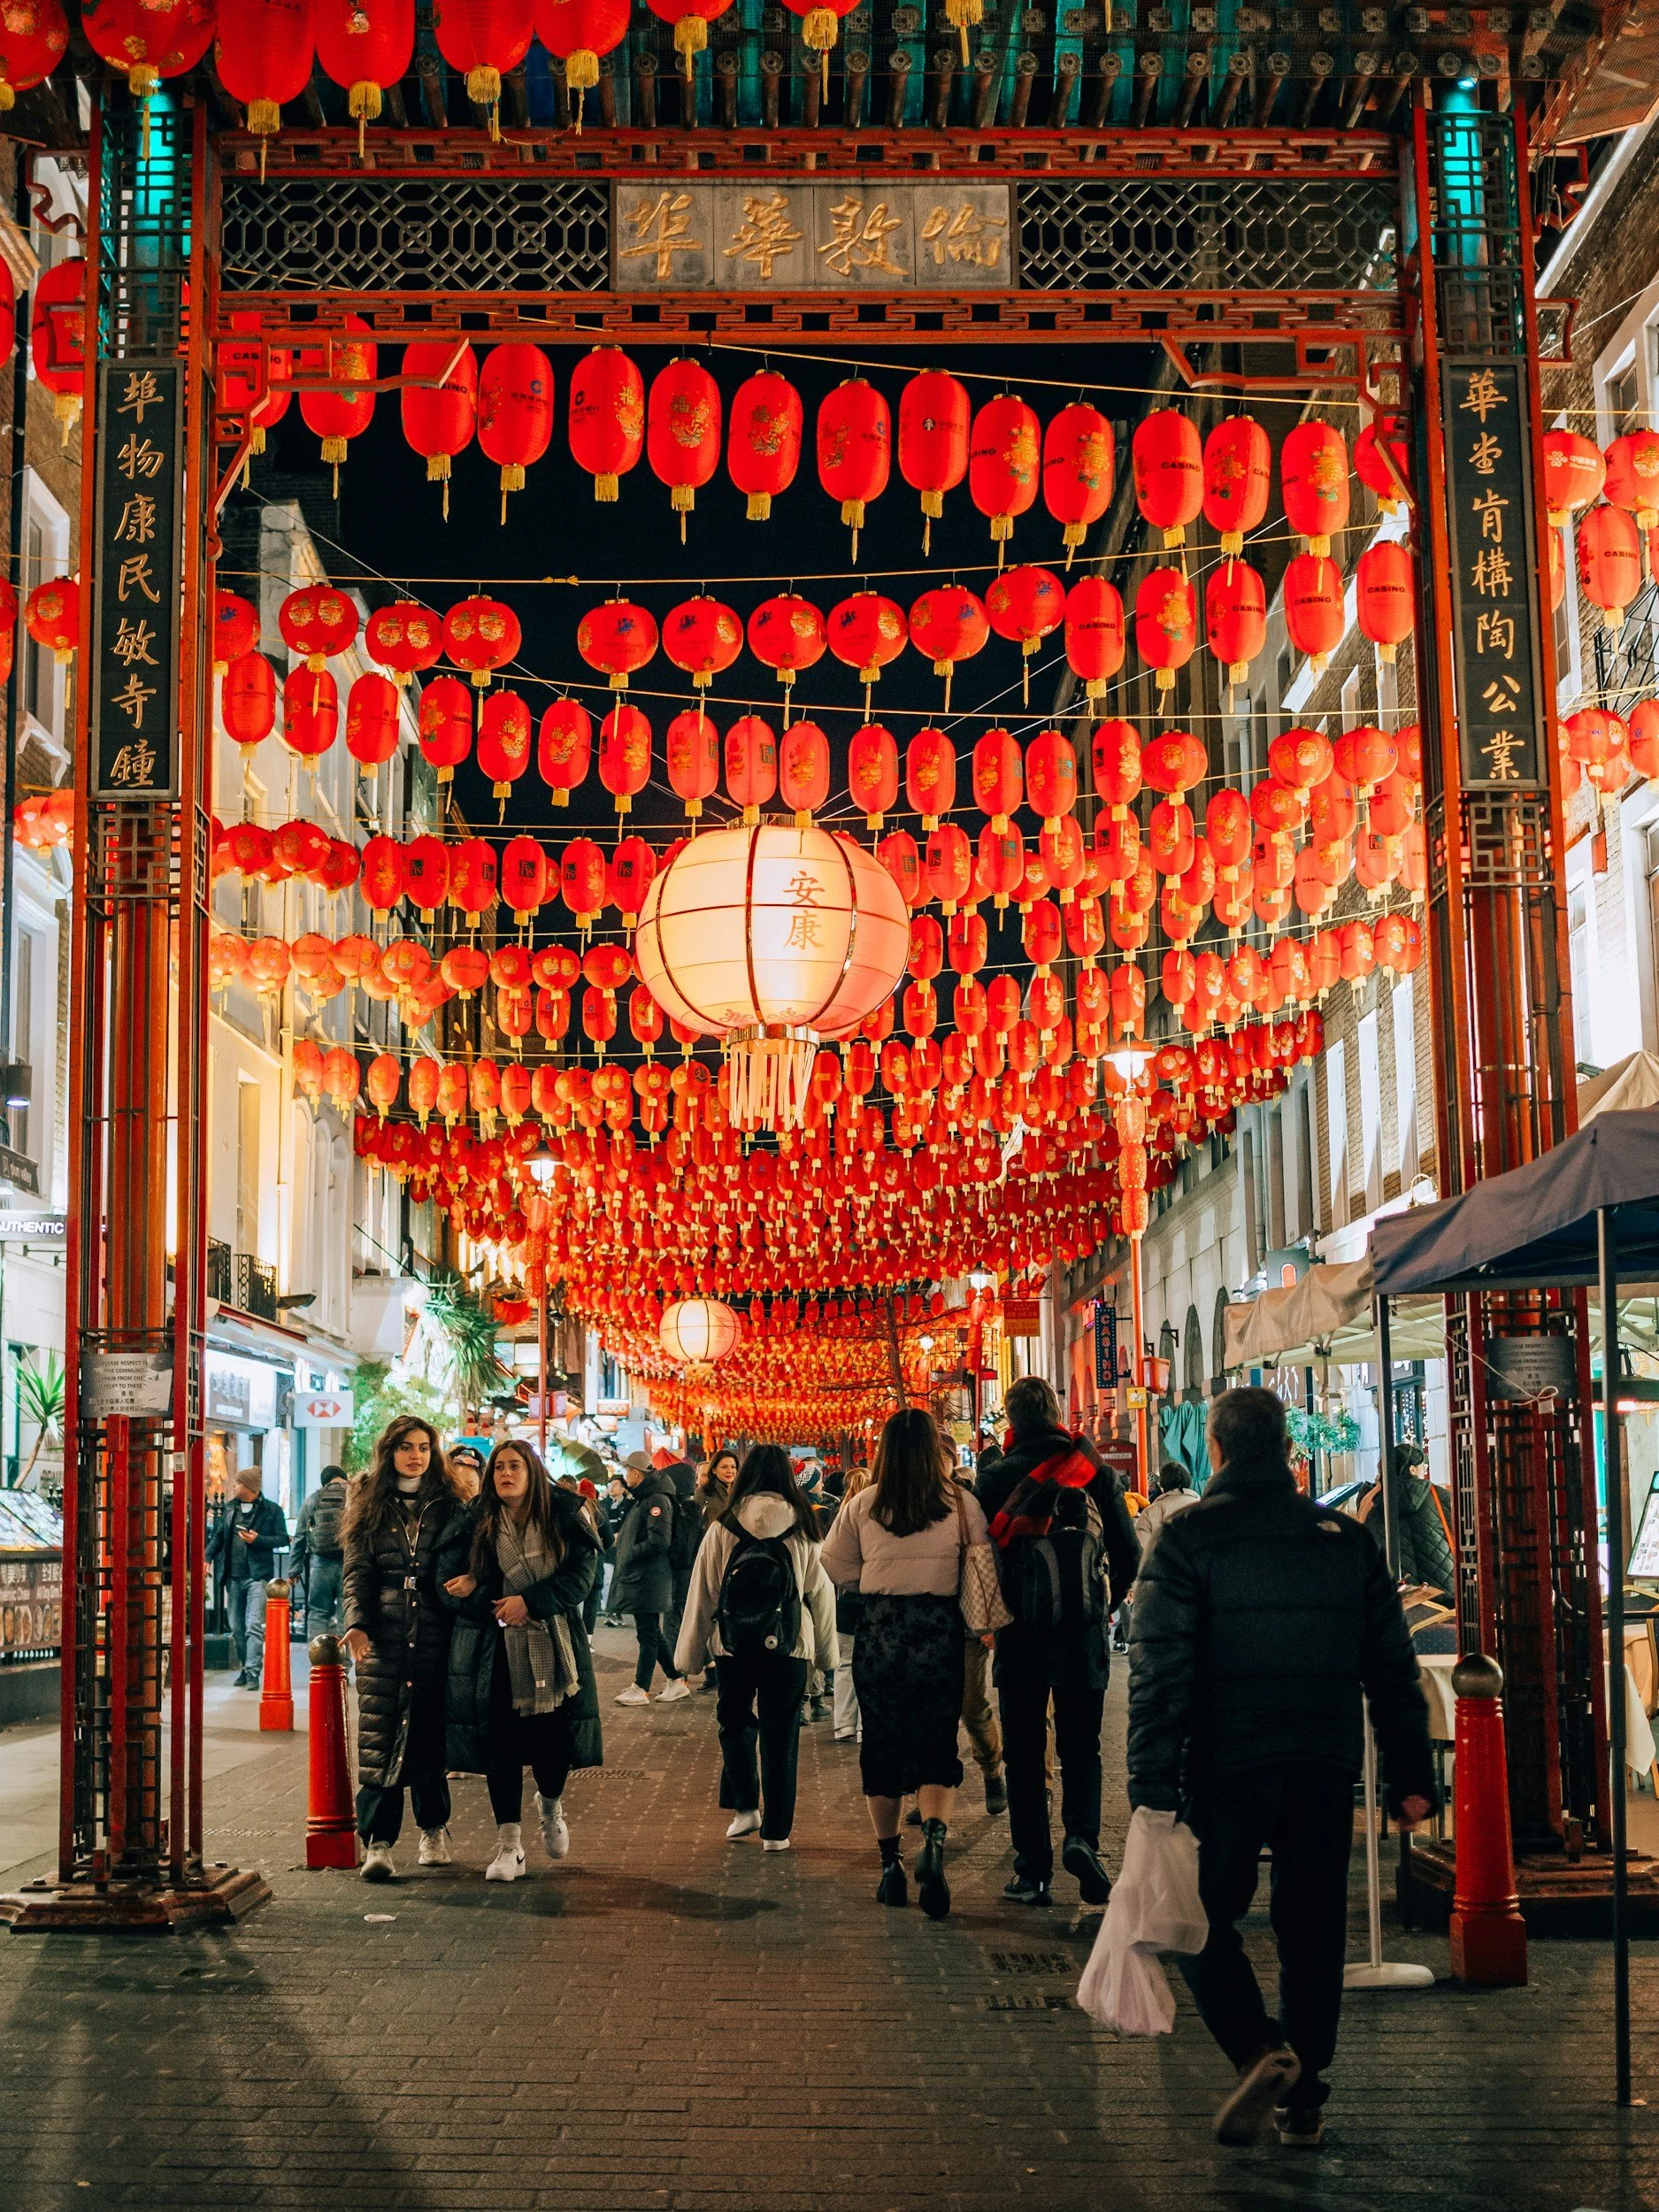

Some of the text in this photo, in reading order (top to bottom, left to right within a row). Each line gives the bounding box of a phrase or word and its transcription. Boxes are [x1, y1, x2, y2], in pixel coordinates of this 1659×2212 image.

[1603, 550, 1638, 560] CASINO
[1294, 595, 1332, 605] CASINO
[1079, 622, 1117, 631] CASINO
[783, 870, 826, 951] 安康
[1100, 1314, 1113, 1382] CASINO
